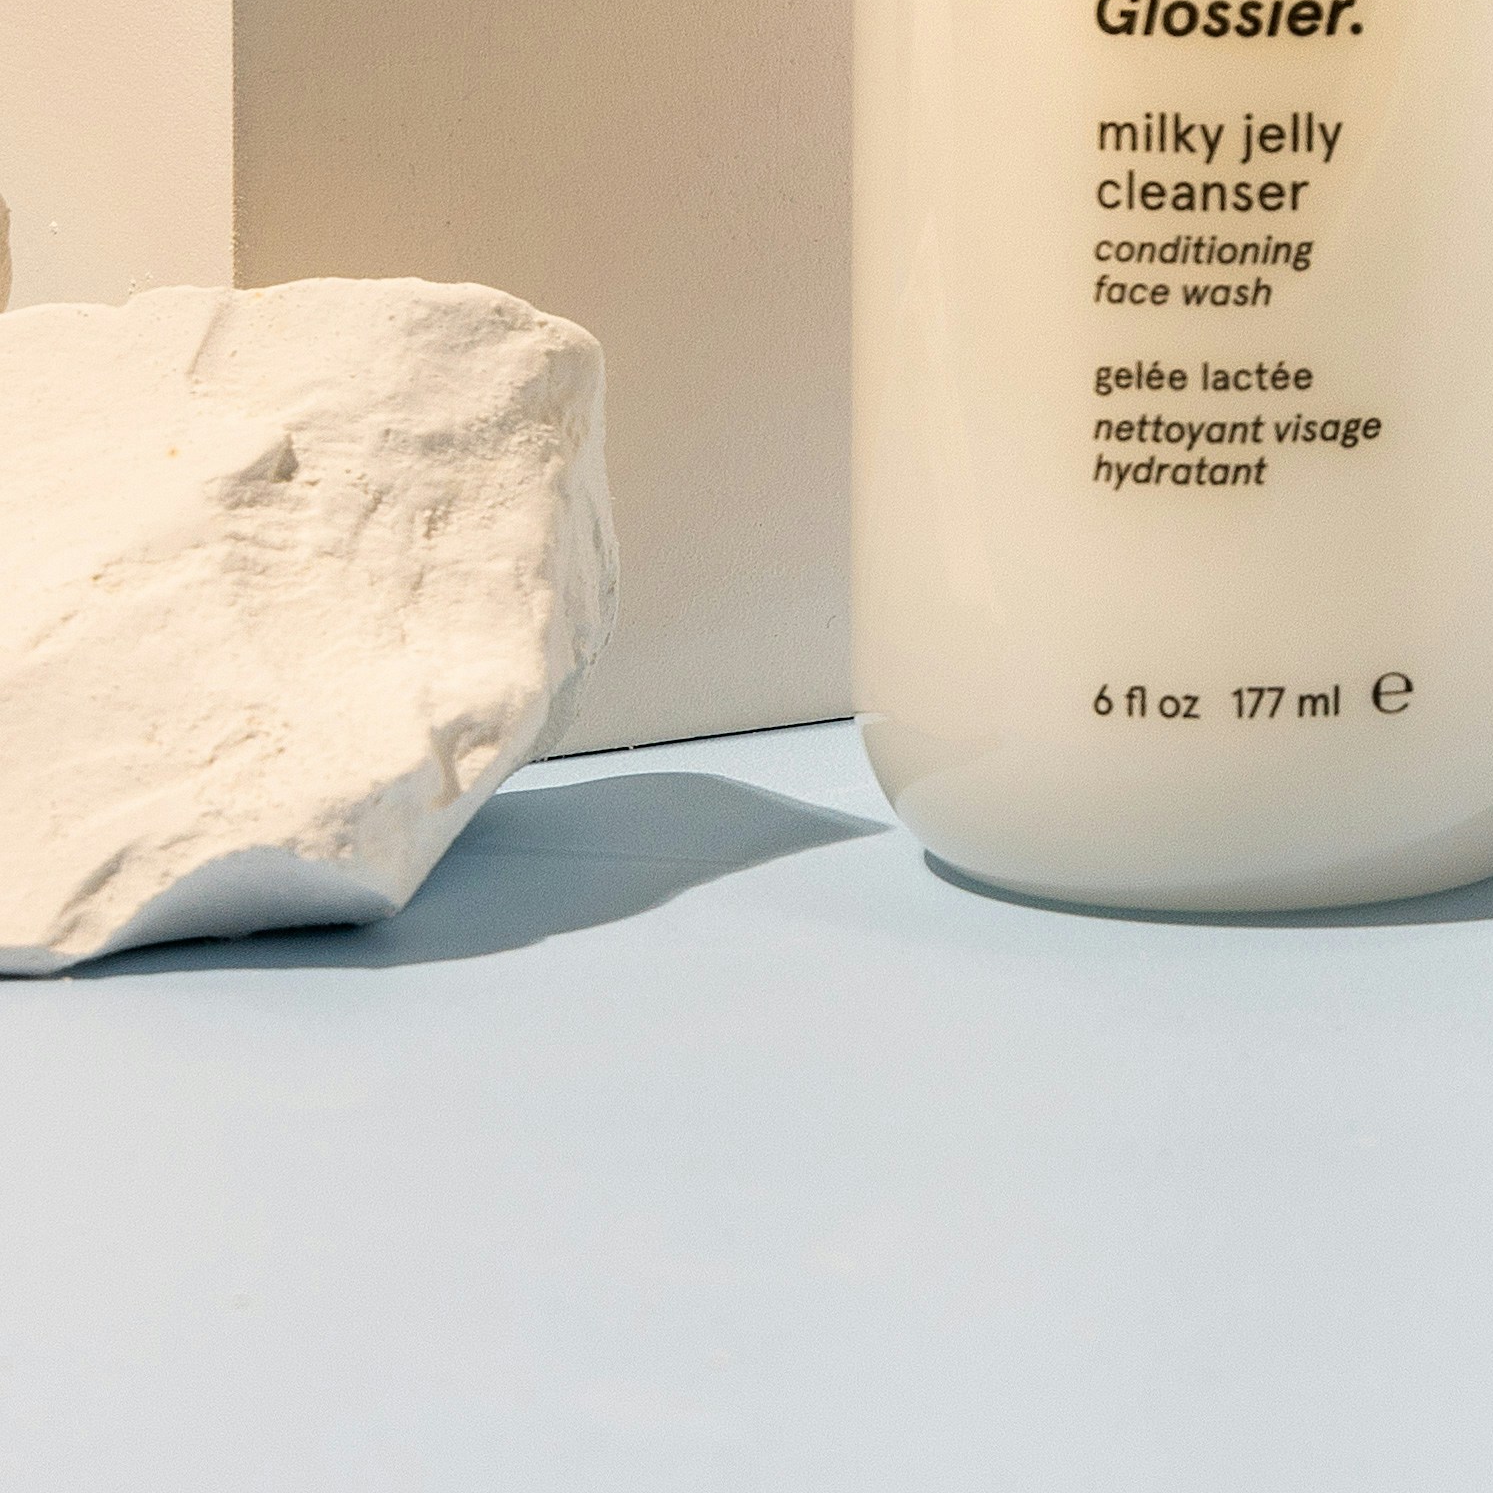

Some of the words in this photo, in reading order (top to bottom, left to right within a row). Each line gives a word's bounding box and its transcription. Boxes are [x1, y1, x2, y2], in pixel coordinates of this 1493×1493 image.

[1099, 112, 1224, 164] milky
[1241, 112, 1342, 164] jelly
[1097, 170, 1309, 212] cleanser
[1094, 235, 1314, 272] conditioning
[1094, 274, 1170, 306] face
[1182, 277, 1272, 307] wash
[1094, 361, 1188, 397] gelée
[1202, 361, 1313, 391] lactée
[1094, 415, 1264, 451] nettoyant
[1274, 414, 1382, 449] visage
[1093, 455, 1267, 491] hydratant
[1093, 684, 1114, 716] 6
[1125, 685, 1147, 717] fl
[1158, 694, 1200, 719] oz
[1232, 687, 1285, 719] 177
[1298, 685, 1340, 718] ml
